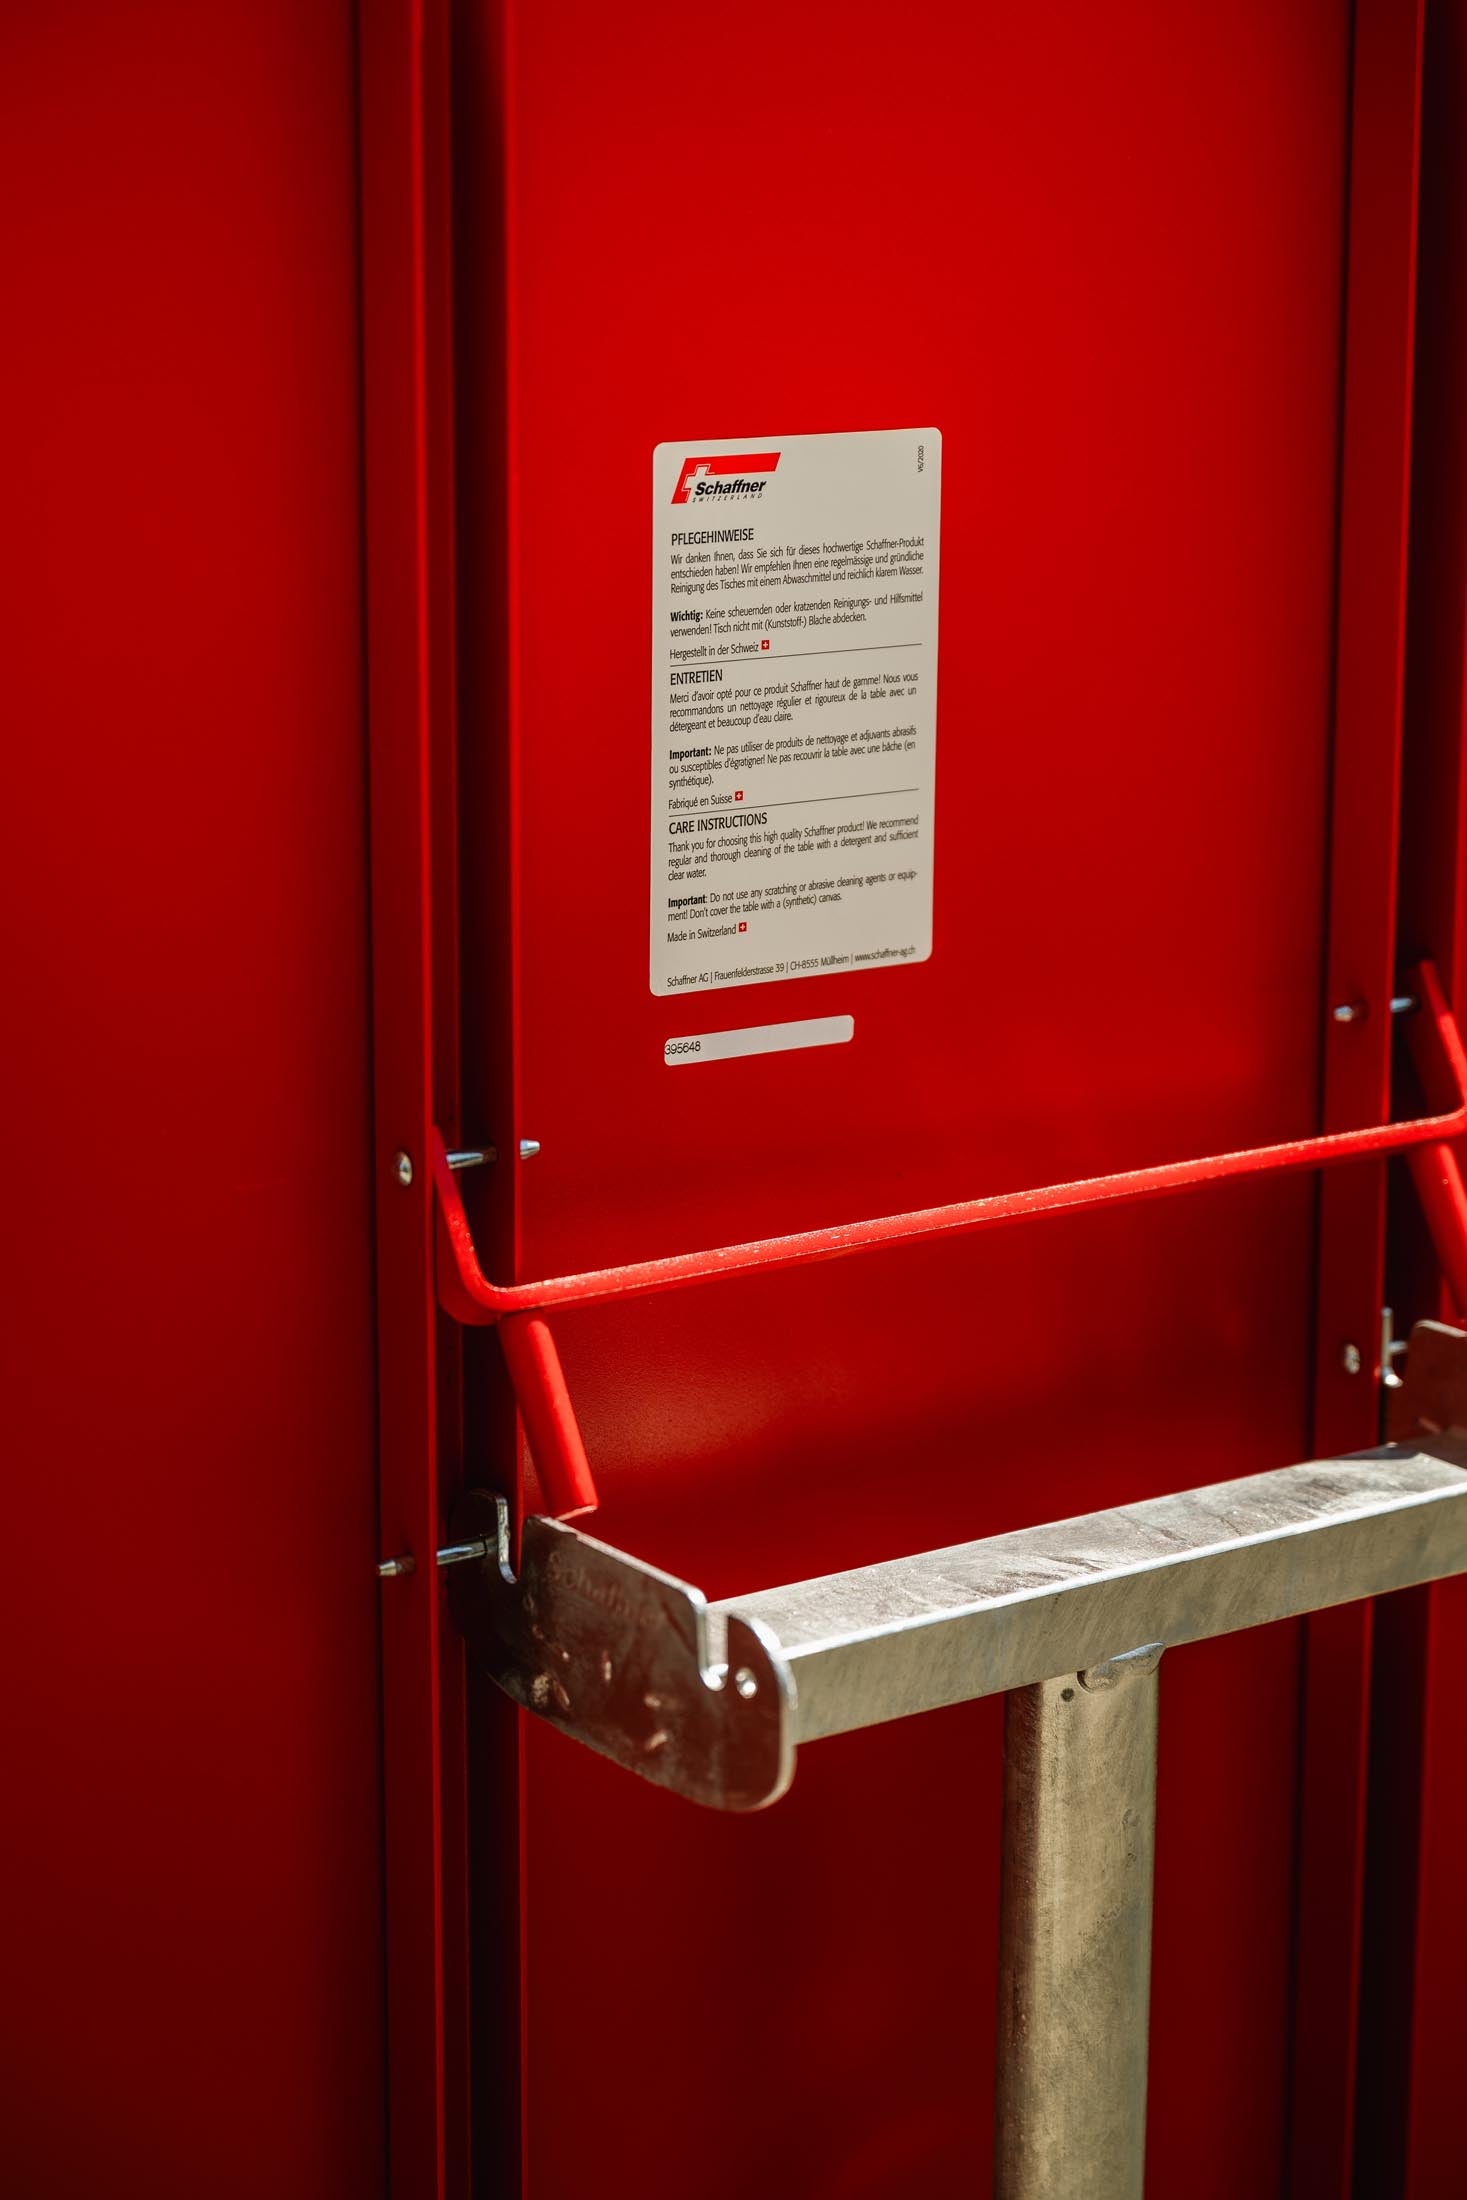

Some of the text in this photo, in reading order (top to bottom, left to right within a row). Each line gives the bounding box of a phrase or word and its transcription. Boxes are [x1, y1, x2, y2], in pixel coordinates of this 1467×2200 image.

[692, 493, 763, 504] SWITZERLAND
[695, 479, 767, 496] Schaffner
[670, 536, 924, 565] Wir danken Ihnen, dass Sie sich für dieses hochwertige Schaffner-Produkt
[671, 528, 754, 546] PFLEGEHINWEISE
[670, 550, 924, 579] entschieden haben! Wir empfehlen Ihnen eine regelmässige und gründliche
[670, 565, 924, 595] Reinigung des Tisches mit einem Abwaschmittel und reichlich klarem Wasser.
[670, 593, 888, 623] Wichtig: Keine scheuernden oder kratzenden Reinigungs- und
[670, 611, 866, 637] verwenden! Tisch nicht mit (Kunststoff-) Blache abdecken.
[669, 641, 759, 661] Hergestellt in der Schweiz
[669, 691, 689, 704] Merci
[716, 688, 732, 702] opté
[734, 688, 751, 701] pour
[752, 687, 762, 697] ce
[763, 682, 789, 697] produit
[790, 680, 822, 693] Schaffner
[824, 678, 840, 689] haut
[841, 676, 851, 688] de
[852, 674, 881, 689] gamme!
[882, 673, 901, 684] Nous
[670, 668, 723, 686] ENTRETIEN
[669, 687, 887, 718] recommandons un nettoyage régulier et rigoureux de la table
[708, 718, 716, 728] et
[716, 716, 752, 728] beaucoup
[773, 710, 793, 722] claire.
[669, 728, 891, 762] Important: Ne pas utiliser de produits de nettoyage et adjuvants
[668, 765, 679, 774] ou
[680, 758, 722, 774] susceptibles
[767, 753, 778, 764] Ne
[779, 753, 792, 765] pas
[793, 748, 822, 761] recouvrir
[823, 747, 830, 758] la
[831, 745, 848, 758] table
[849, 746, 866, 756] avec
[668, 773, 714, 791] synthétique).
[668, 793, 733, 810] Fabriqué en Suisse
[668, 811, 767, 835] CARE INSTRUCTIONS
[668, 820, 878, 853] Thank you for choosing this high quality Schaffner We
[668, 834, 872, 869] regular and thorough cleaning of the table with detergent
[667, 868, 707, 881] clear water.
[667, 909, 688, 922] ment!
[709, 906, 728, 917] cover
[729, 903, 741, 914] the
[742, 900, 759, 912] table
[760, 898, 775, 910] with
[776, 900, 781, 908] a
[782, 893, 817, 909] (synthetic)
[818, 892, 842, 903] canvas.
[668, 878, 835, 910] Important: Do not use any scratching or abrasive
[667, 923, 736, 942] Made in Switzerland
[666, 974, 697, 987] Schaffner
[698, 972, 709, 983] AG
[714, 966, 774, 981] Frauenfelderstrasse
[775, 962, 785, 973] 39
[789, 958, 819, 971] CH-8555
[820, 954, 849, 966] Müllheim
[664, 1041, 701, 1056] 395648
